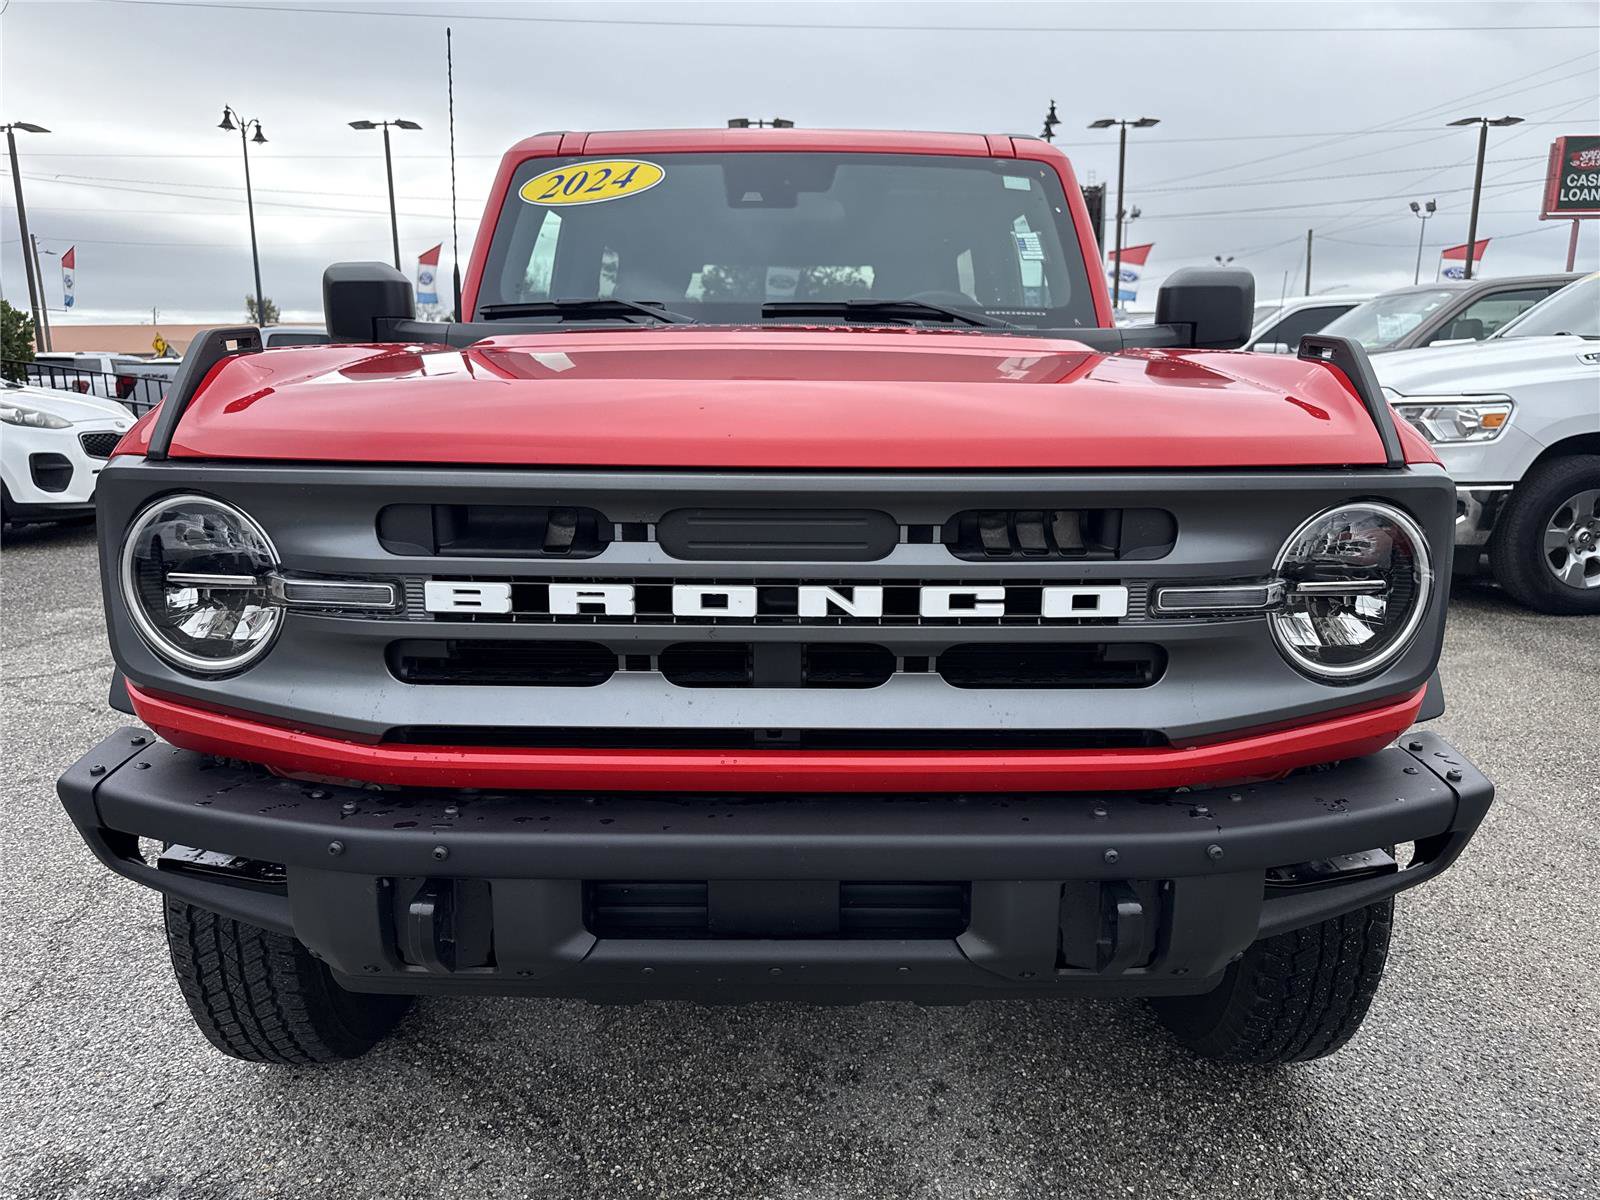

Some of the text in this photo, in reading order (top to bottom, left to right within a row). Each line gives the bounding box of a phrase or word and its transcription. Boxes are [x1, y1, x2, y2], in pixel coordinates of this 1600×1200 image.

[537, 164, 640, 200] 2024
[1566, 174, 1600, 187] CAS
[424, 580, 1128, 618] BRONCO
